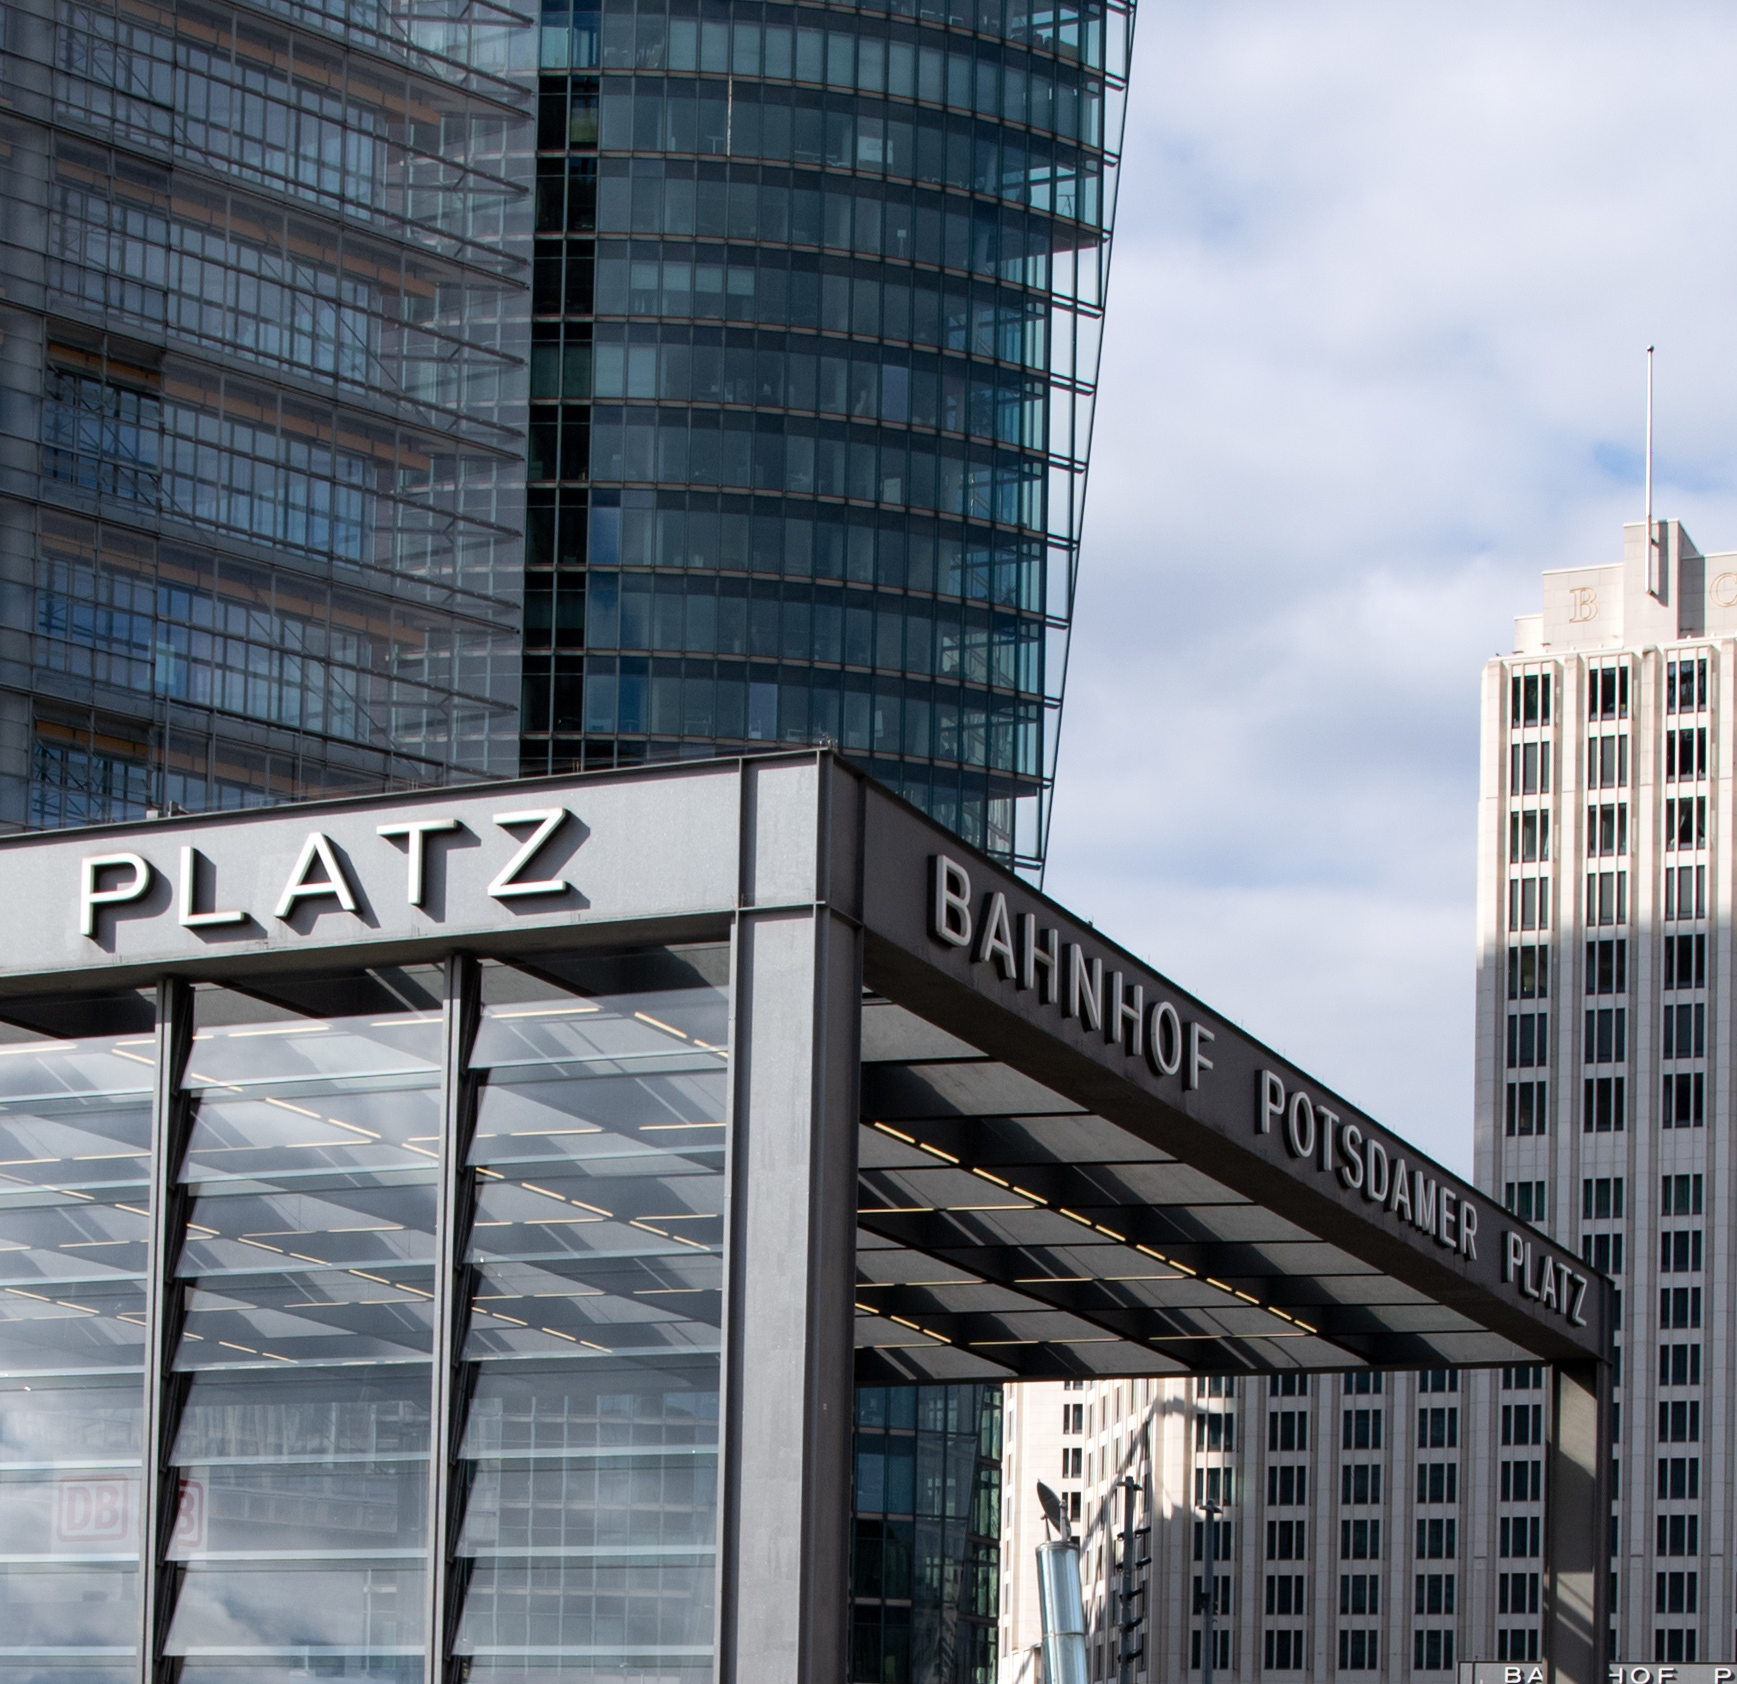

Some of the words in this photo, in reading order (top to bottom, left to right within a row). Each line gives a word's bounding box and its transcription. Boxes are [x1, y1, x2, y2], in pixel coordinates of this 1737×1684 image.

[1568, 587, 1599, 623] B
[79, 807, 567, 936] PLATZ
[934, 853, 1216, 1089] BAHNHOF
[1260, 1069, 1479, 1261] POTSDAMER
[1505, 1230, 1589, 1327] PLATZ
[64, 1483, 121, 1532] DB
[1504, 1666, 1675, 1684] BAHOF
